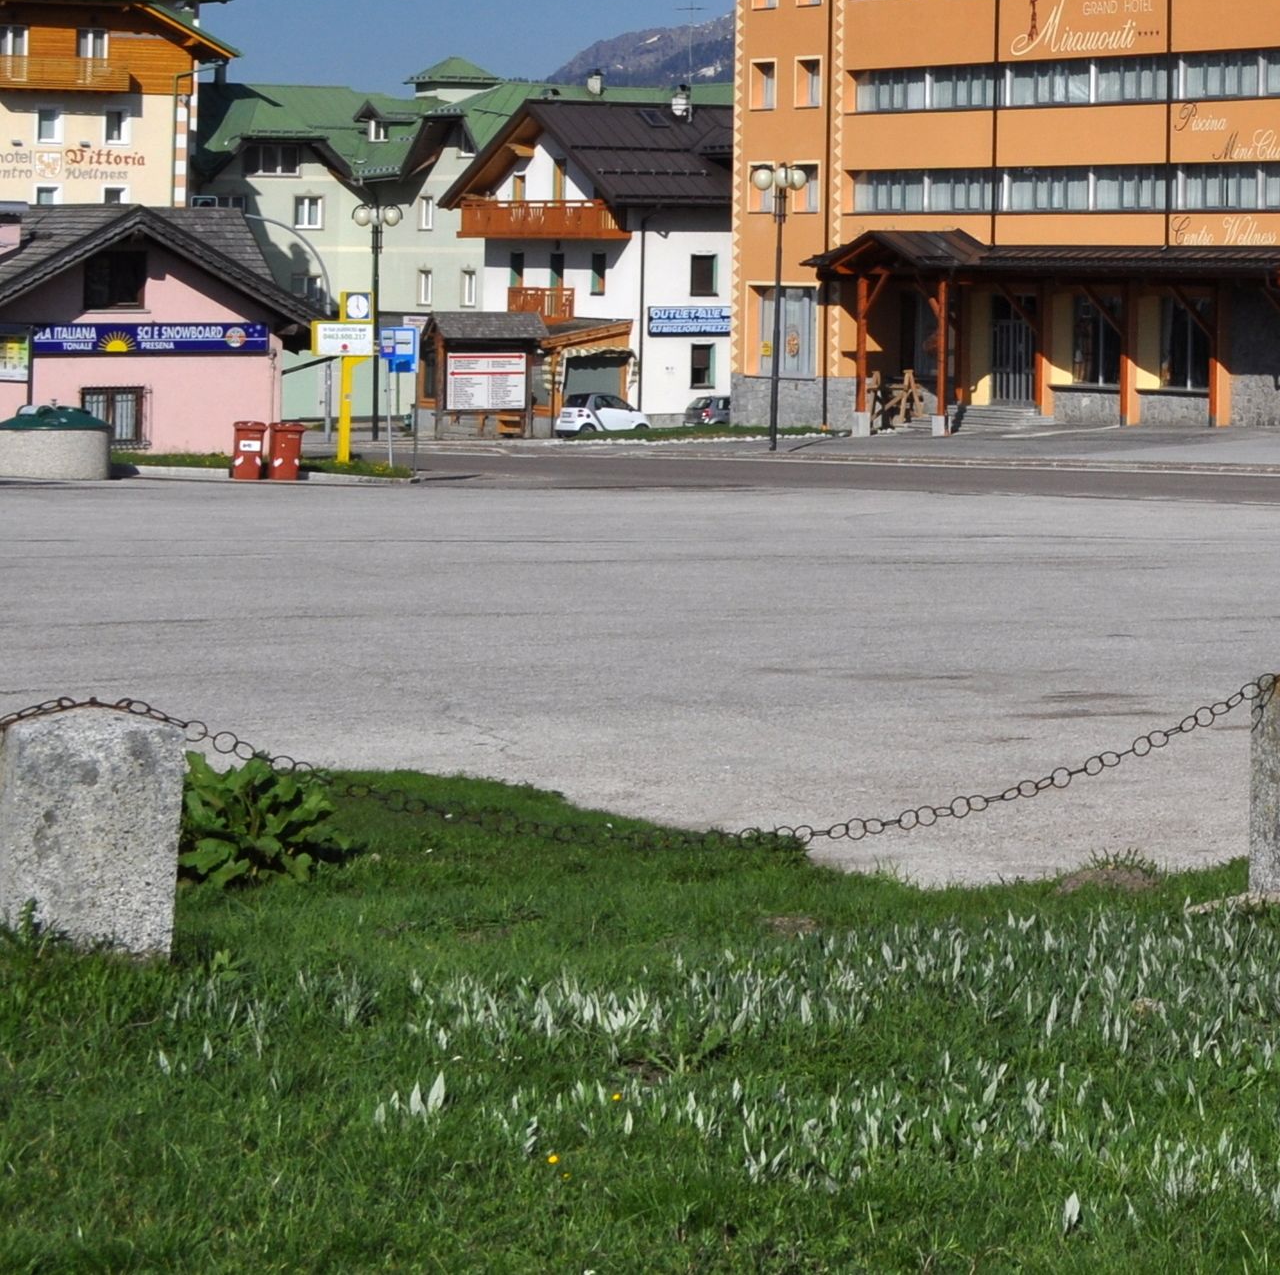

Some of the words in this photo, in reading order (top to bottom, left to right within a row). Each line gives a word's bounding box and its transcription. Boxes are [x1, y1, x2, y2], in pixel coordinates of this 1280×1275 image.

[1082, 0, 1118, 16] GRAND
[1174, 102, 1227, 131] Piscina
[1212, 131, 1254, 160] Mini
[65, 148, 146, 166] Vittoria
[65, 167, 128, 180] Wellness
[1171, 216, 1214, 245] Centro
[1222, 216, 1277, 245] Wellness
[652, 309, 698, 319] OUTLET
[54, 326, 97, 339] ITALIANA
[137, 326, 151, 339] SCI
[153, 327, 160, 339] E
[161, 326, 223, 339] SNOWBOARD
[63, 342, 93, 350] TONALE
[141, 341, 174, 350] PRESENA
